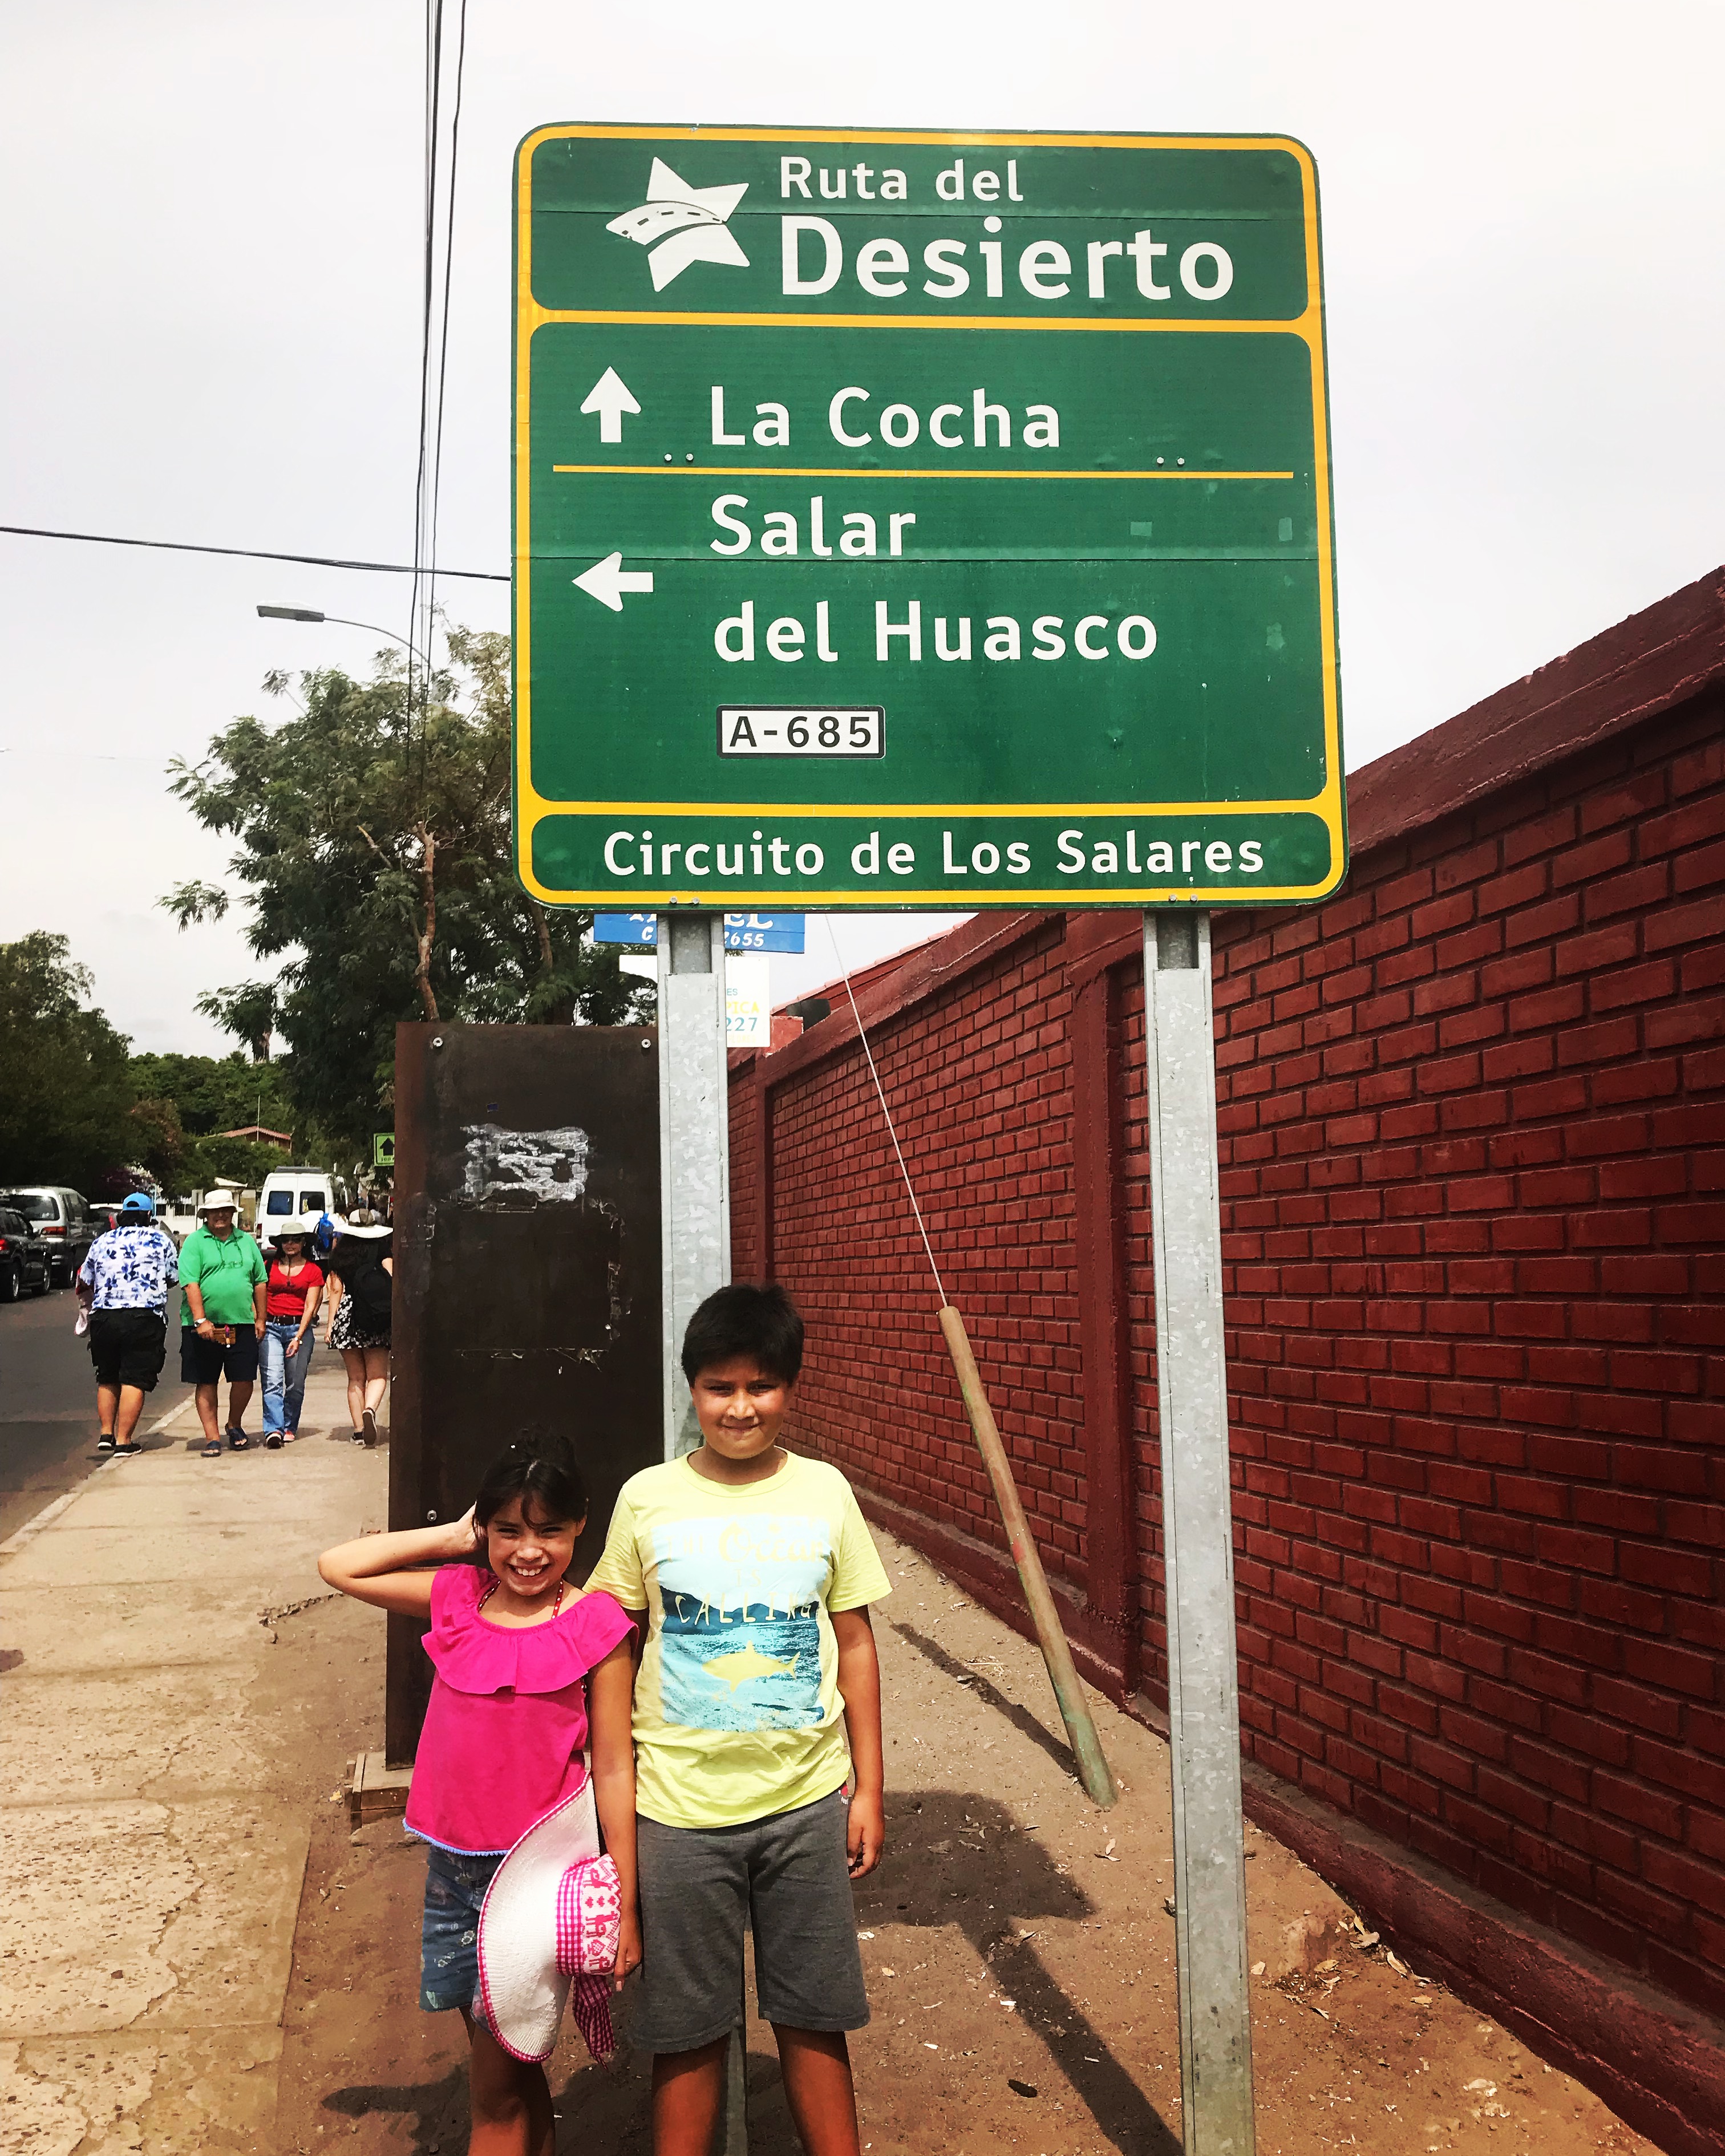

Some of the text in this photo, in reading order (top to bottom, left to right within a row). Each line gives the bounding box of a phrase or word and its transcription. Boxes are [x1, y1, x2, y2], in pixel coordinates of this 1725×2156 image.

[781, 156, 1023, 201] Ruta del
[782, 216, 1233, 300] Desierto
[712, 386, 1059, 448] La Cocha
[710, 495, 916, 556] Salar
[715, 601, 1156, 662] del Huasco
[729, 716, 871, 748] A-685
[605, 830, 1263, 875] Circuito de Los Salares
[675, 1590, 817, 1626] CALLING
